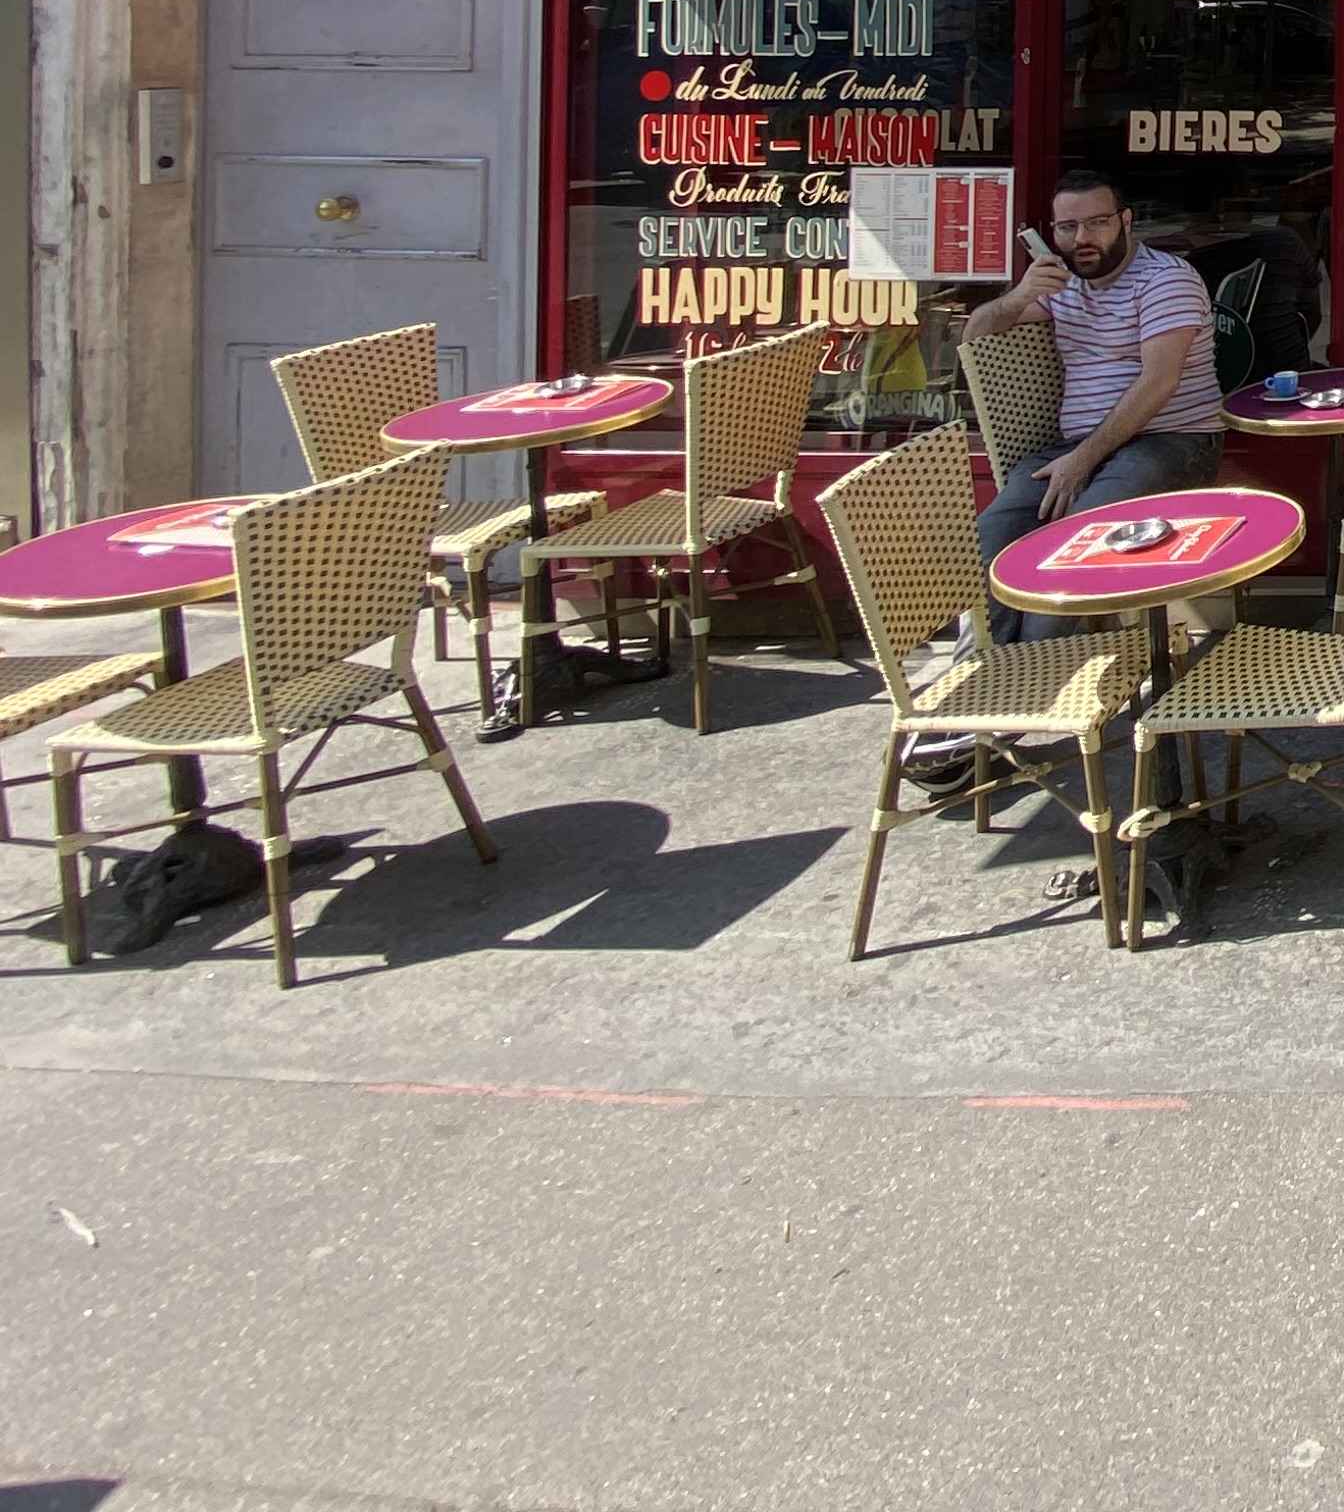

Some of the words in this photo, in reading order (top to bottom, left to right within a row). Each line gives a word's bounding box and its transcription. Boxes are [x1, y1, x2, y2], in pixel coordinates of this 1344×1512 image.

[676, 66, 708, 101] du
[712, 59, 799, 101] Lundi
[801, 80, 827, 100] au
[820, 69, 928, 101] Vendredi
[639, 114, 768, 165] CUISINE
[808, 113, 940, 167] MAISON
[1128, 109, 1284, 154] BIERES
[669, 166, 783, 207] Produits
[798, 171, 850, 206] Fra
[639, 217, 767, 258] SERVICE
[785, 217, 850, 259] CON
[639, 268, 787, 325] HAPPY
[799, 268, 919, 326] HOUR
[848, 390, 946, 425] ORANGINA
